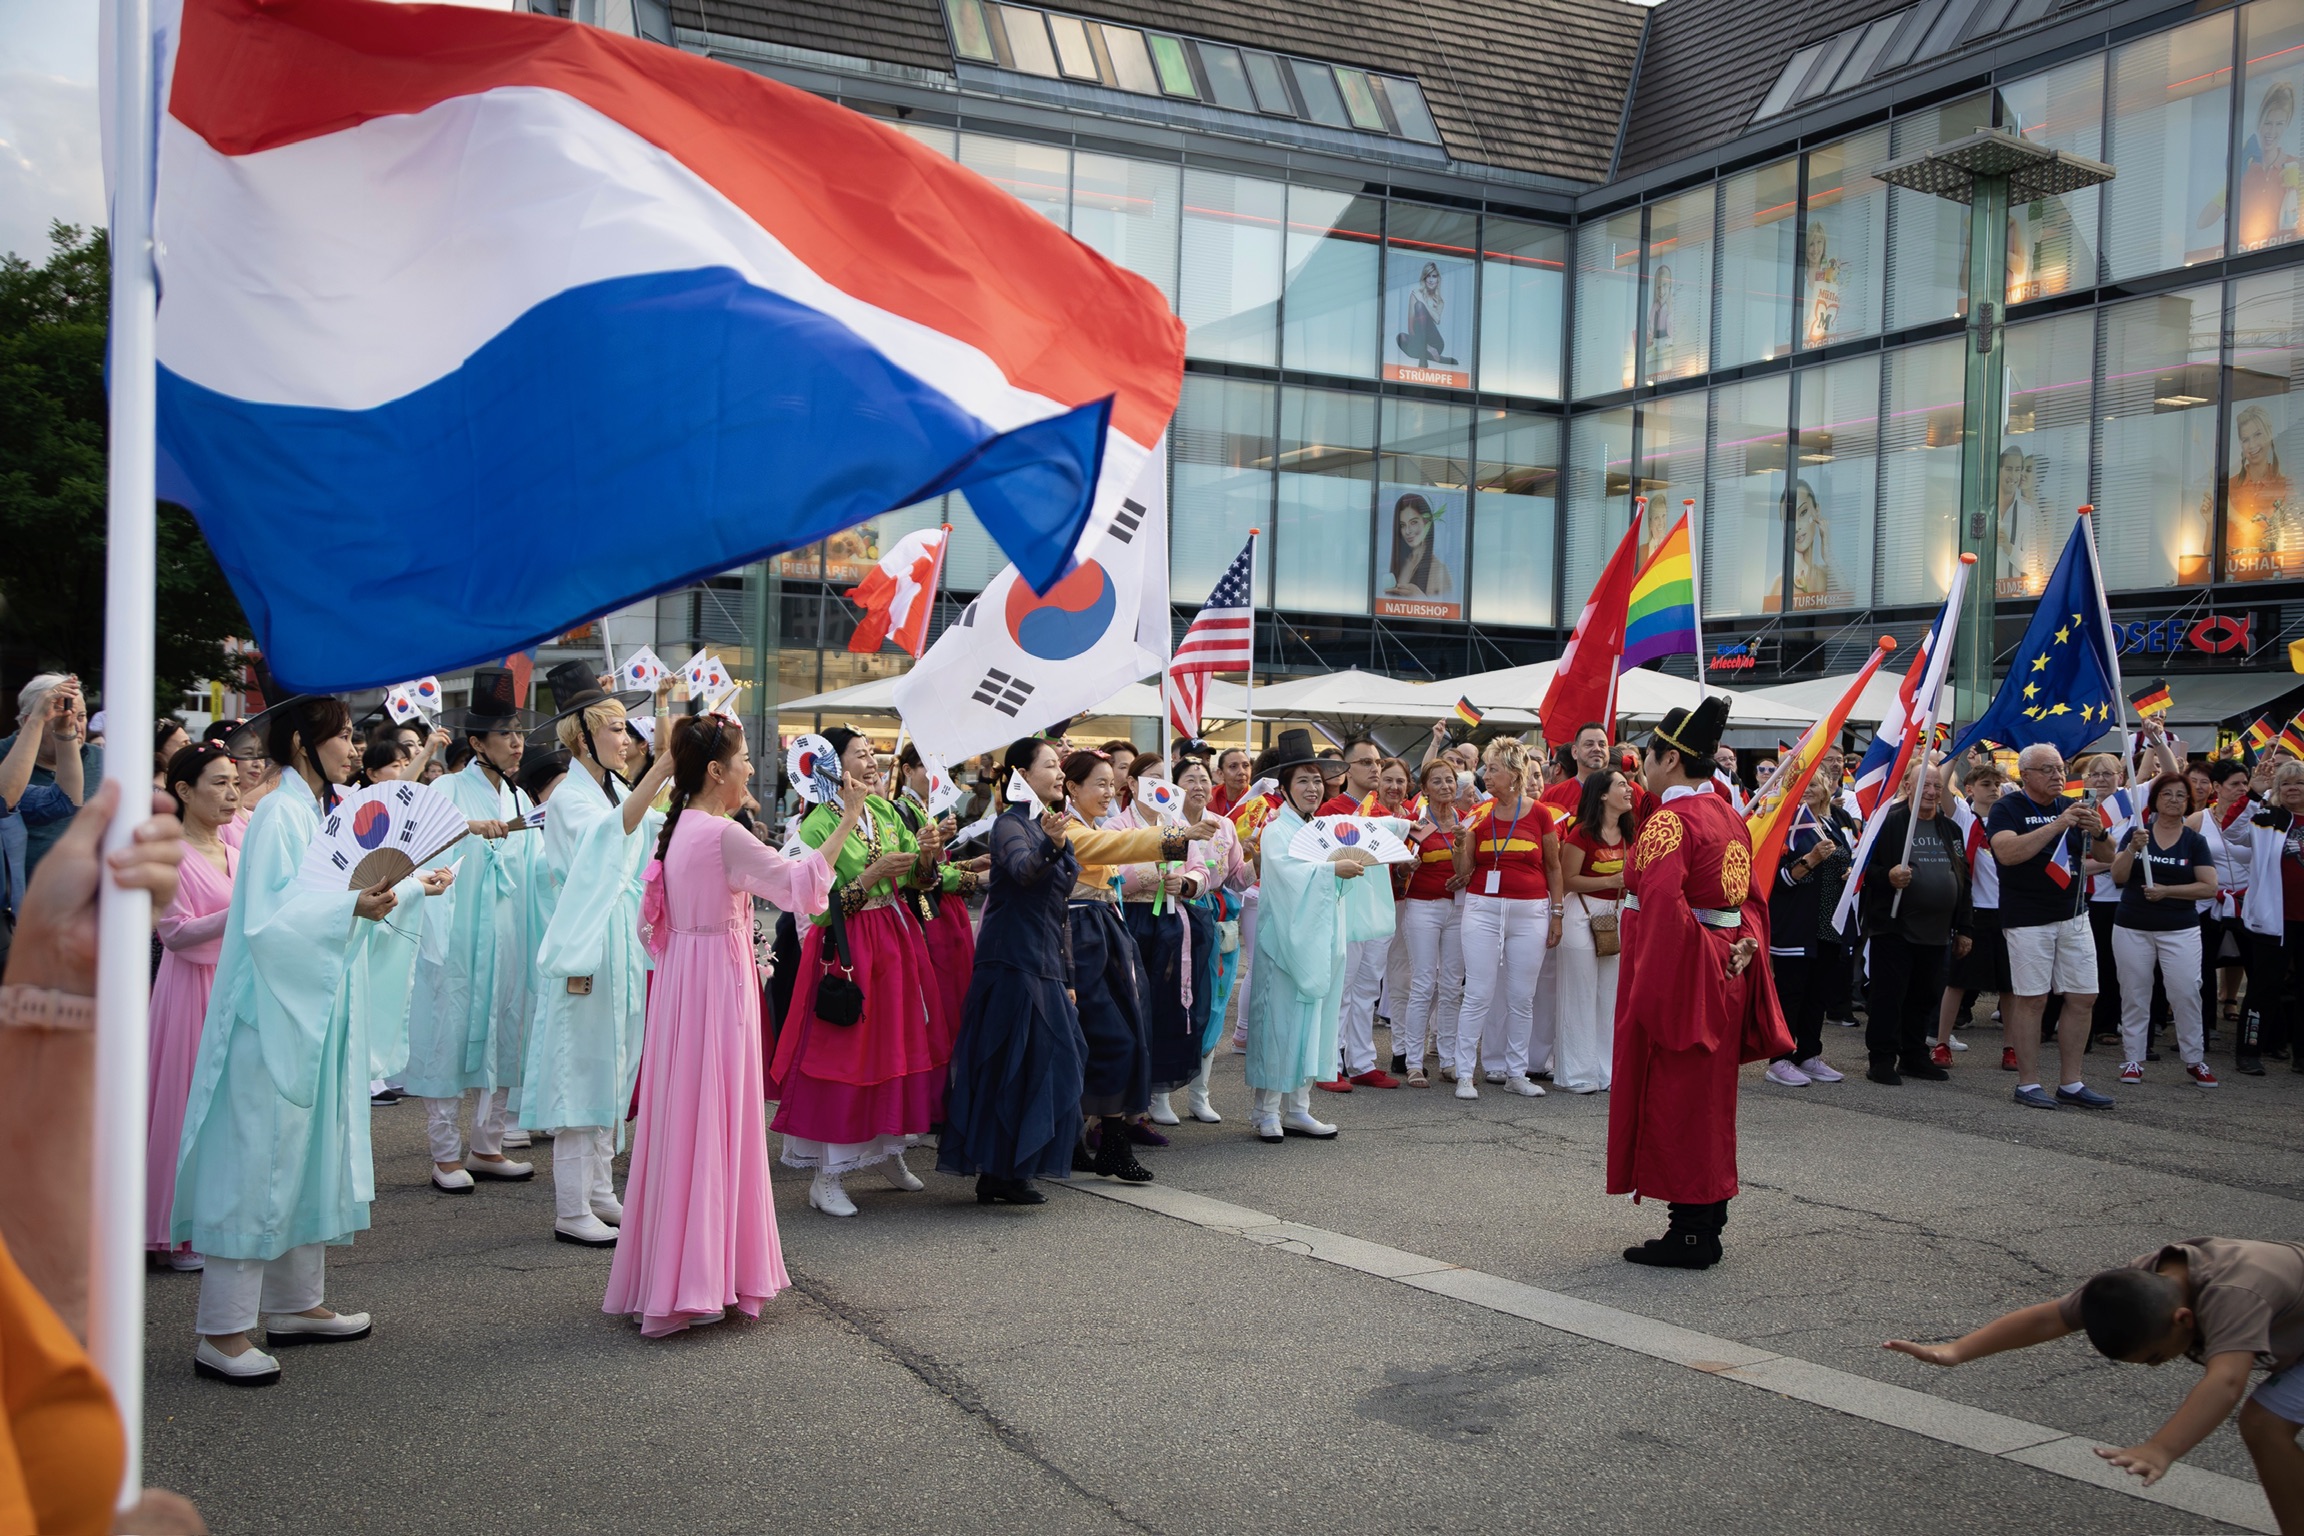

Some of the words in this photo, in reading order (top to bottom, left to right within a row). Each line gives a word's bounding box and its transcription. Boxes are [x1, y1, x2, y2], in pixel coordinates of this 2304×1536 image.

[1398, 368, 1453, 385] STRÜMPFE
[782, 562, 858, 578] PIELWAREN
[1385, 602, 1449, 616] NATURSHOP
[2111, 619, 2185, 654] DSEE
[1710, 655, 1756, 670] Arlecchino
[2025, 814, 2060, 825] FRANC
[1911, 837, 1945, 847] COTLA
